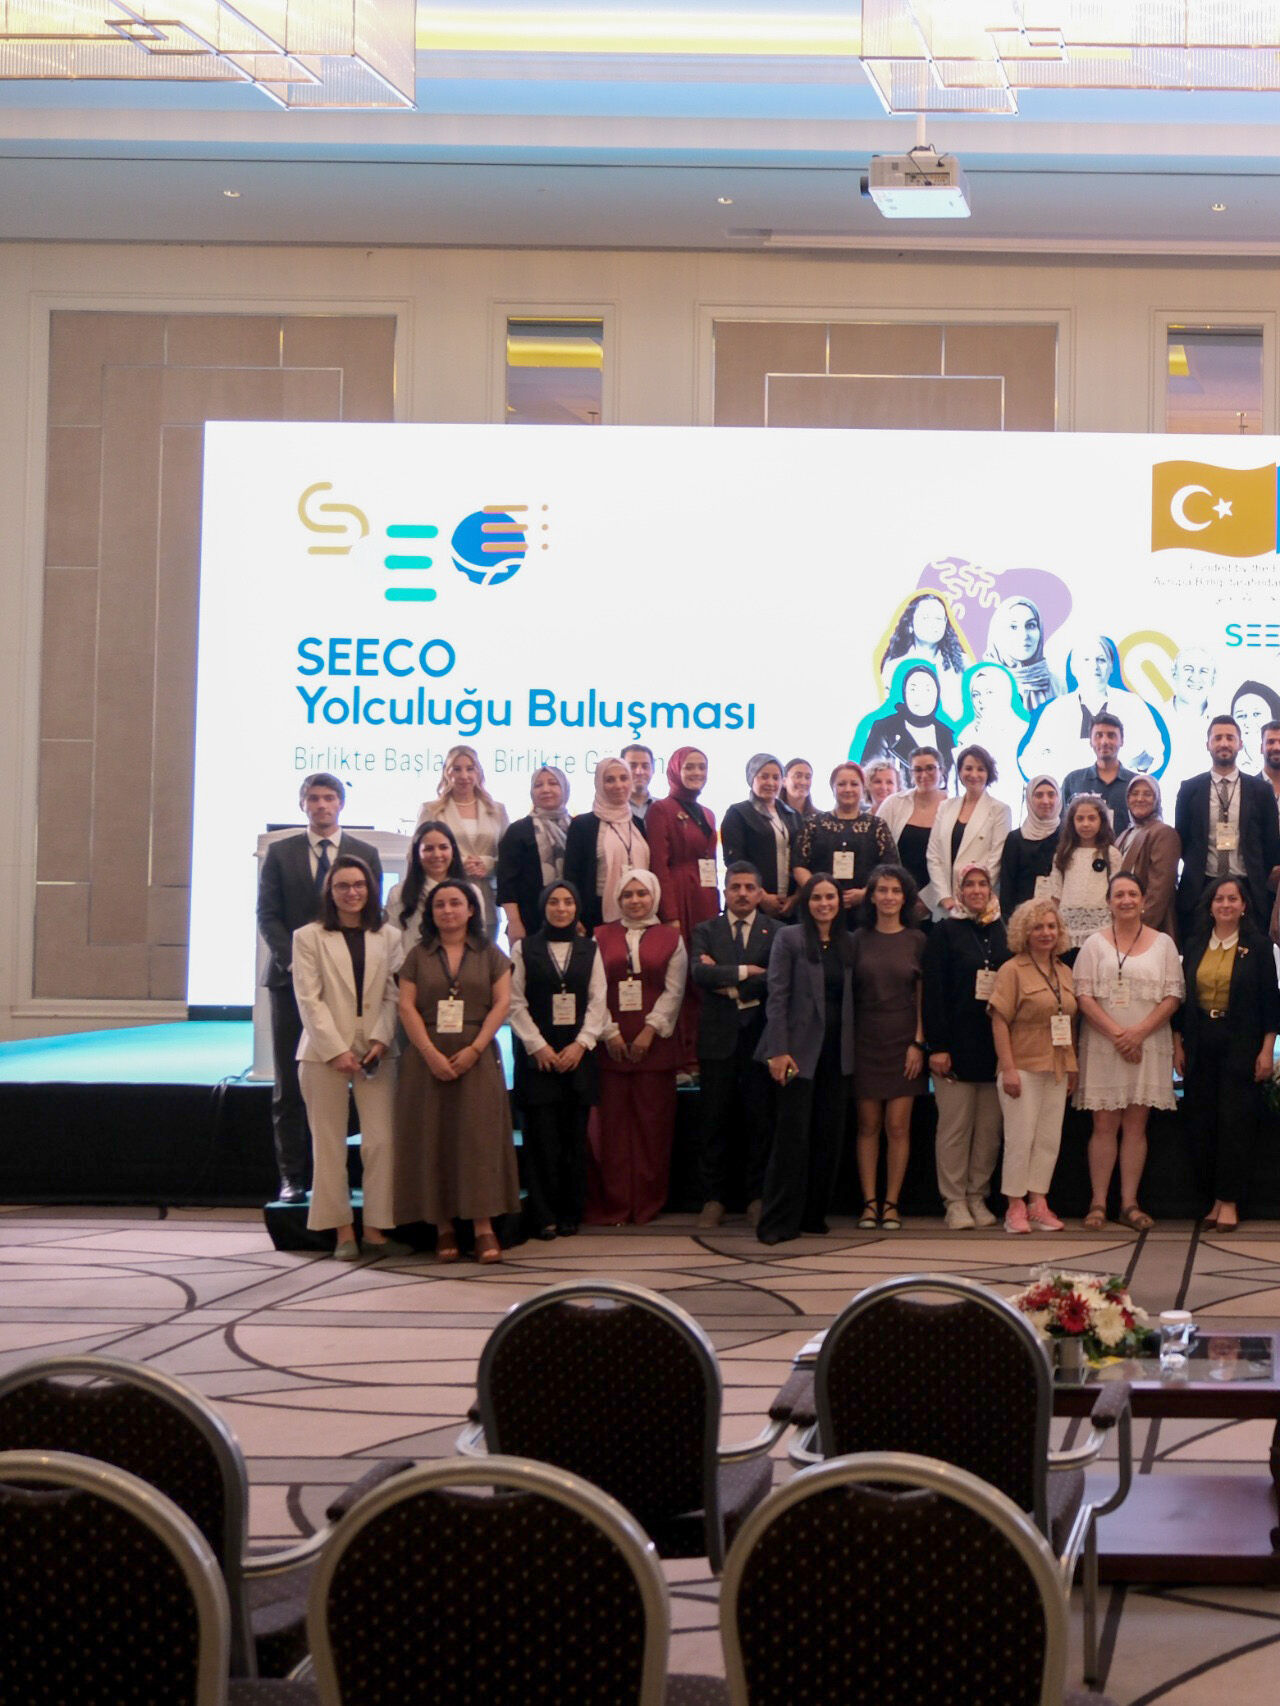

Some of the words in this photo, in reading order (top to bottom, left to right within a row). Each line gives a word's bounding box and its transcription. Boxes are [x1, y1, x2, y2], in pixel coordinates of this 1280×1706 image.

[296, 636, 456, 679] SEECO
[295, 684, 512, 737] Yolculuğu
[528, 688, 755, 740] Buluşması
[294, 746, 376, 771] Birlikte
